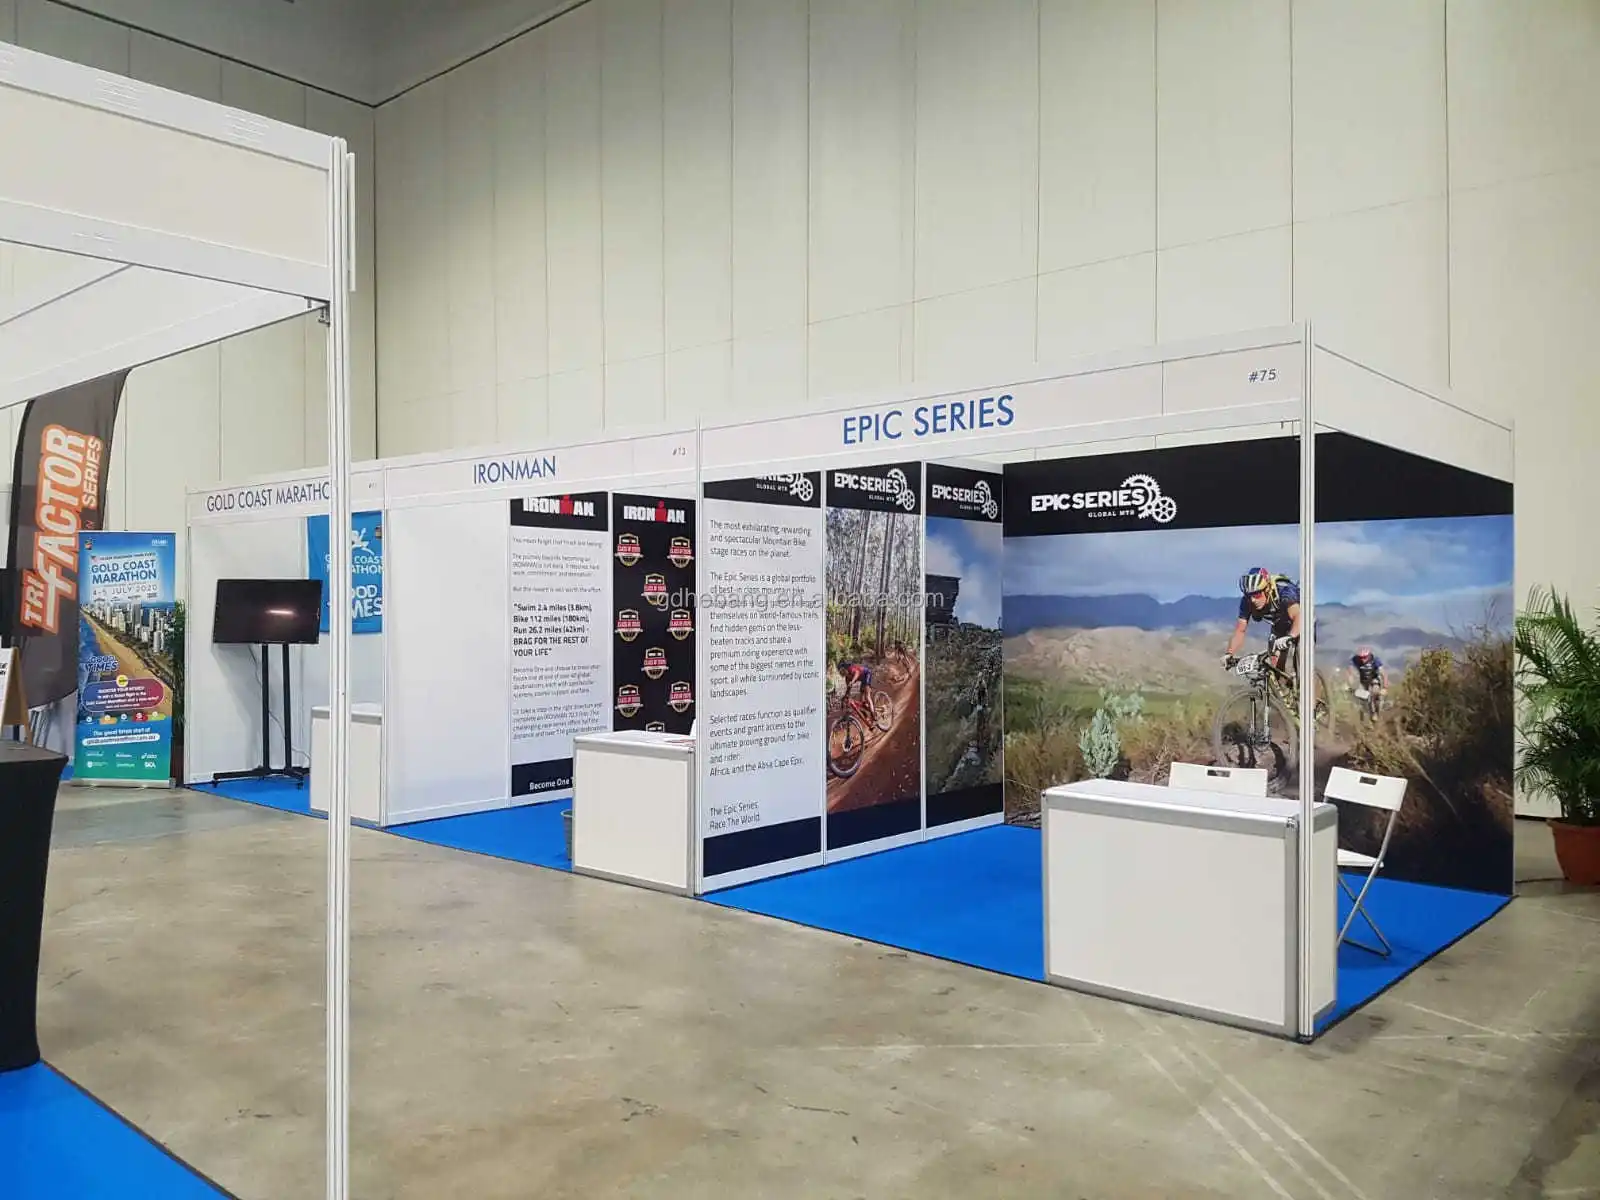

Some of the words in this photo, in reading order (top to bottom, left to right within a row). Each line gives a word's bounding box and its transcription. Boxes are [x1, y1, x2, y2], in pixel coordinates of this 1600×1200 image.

[1248, 369, 1277, 383] #75
[843, 410, 903, 445] EPIC
[913, 394, 1015, 437] SERIES
[473, 455, 556, 485] IRONMAN
[834, 472, 859, 490] EPIC
[860, 476, 901, 494] SERIES
[207, 494, 235, 512] GOLD
[238, 488, 273, 509] COAST
[276, 481, 331, 505] MARATHO
[932, 484, 952, 499] EPIC
[952, 488, 985, 504] SERIES
[1031, 494, 1071, 512] EPIC
[1072, 488, 1145, 510] SERIES
[624, 500, 686, 523] IRONMAN
[1088, 510, 1117, 518] GLOBAL
[1119, 509, 1135, 517] MTB
[37, 428, 86, 631] FACTOR
[82, 437, 101, 509] SERIES
[710, 520, 722, 529] The
[724, 522, 740, 531] most
[724, 535, 760, 544] spectacular
[794, 538, 806, 547] Bike
[710, 548, 728, 557] stage
[759, 548, 768, 557] the
[91, 562, 119, 574] GOLD
[123, 559, 156, 571] COAST
[92, 569, 157, 584] MARATHON
[710, 572, 722, 581] The
[724, 572, 736, 582] Epic
[740, 573, 758, 582] Series
[772, 574, 790, 584] global
[112, 584, 132, 595] JULY
[749, 625, 765, 634] gems
[710, 650, 740, 660] premium
[710, 664, 728, 672] some
[730, 662, 737, 671] of
[751, 662, 772, 671] biggest
[710, 714, 738, 724] Selected
[710, 728, 732, 737] events
[734, 726, 745, 734] and
[747, 724, 764, 736] grant
[795, 720, 805, 728] the
[710, 741, 738, 751] ultimate
[764, 735, 785, 746] ground
[732, 764, 744, 773] and
[746, 762, 756, 771] the
[530, 780, 556, 790] Become
[556, 778, 570, 786] One
[710, 808, 722, 816] The
[724, 803, 737, 814] Epic
[728, 816, 739, 826] The
